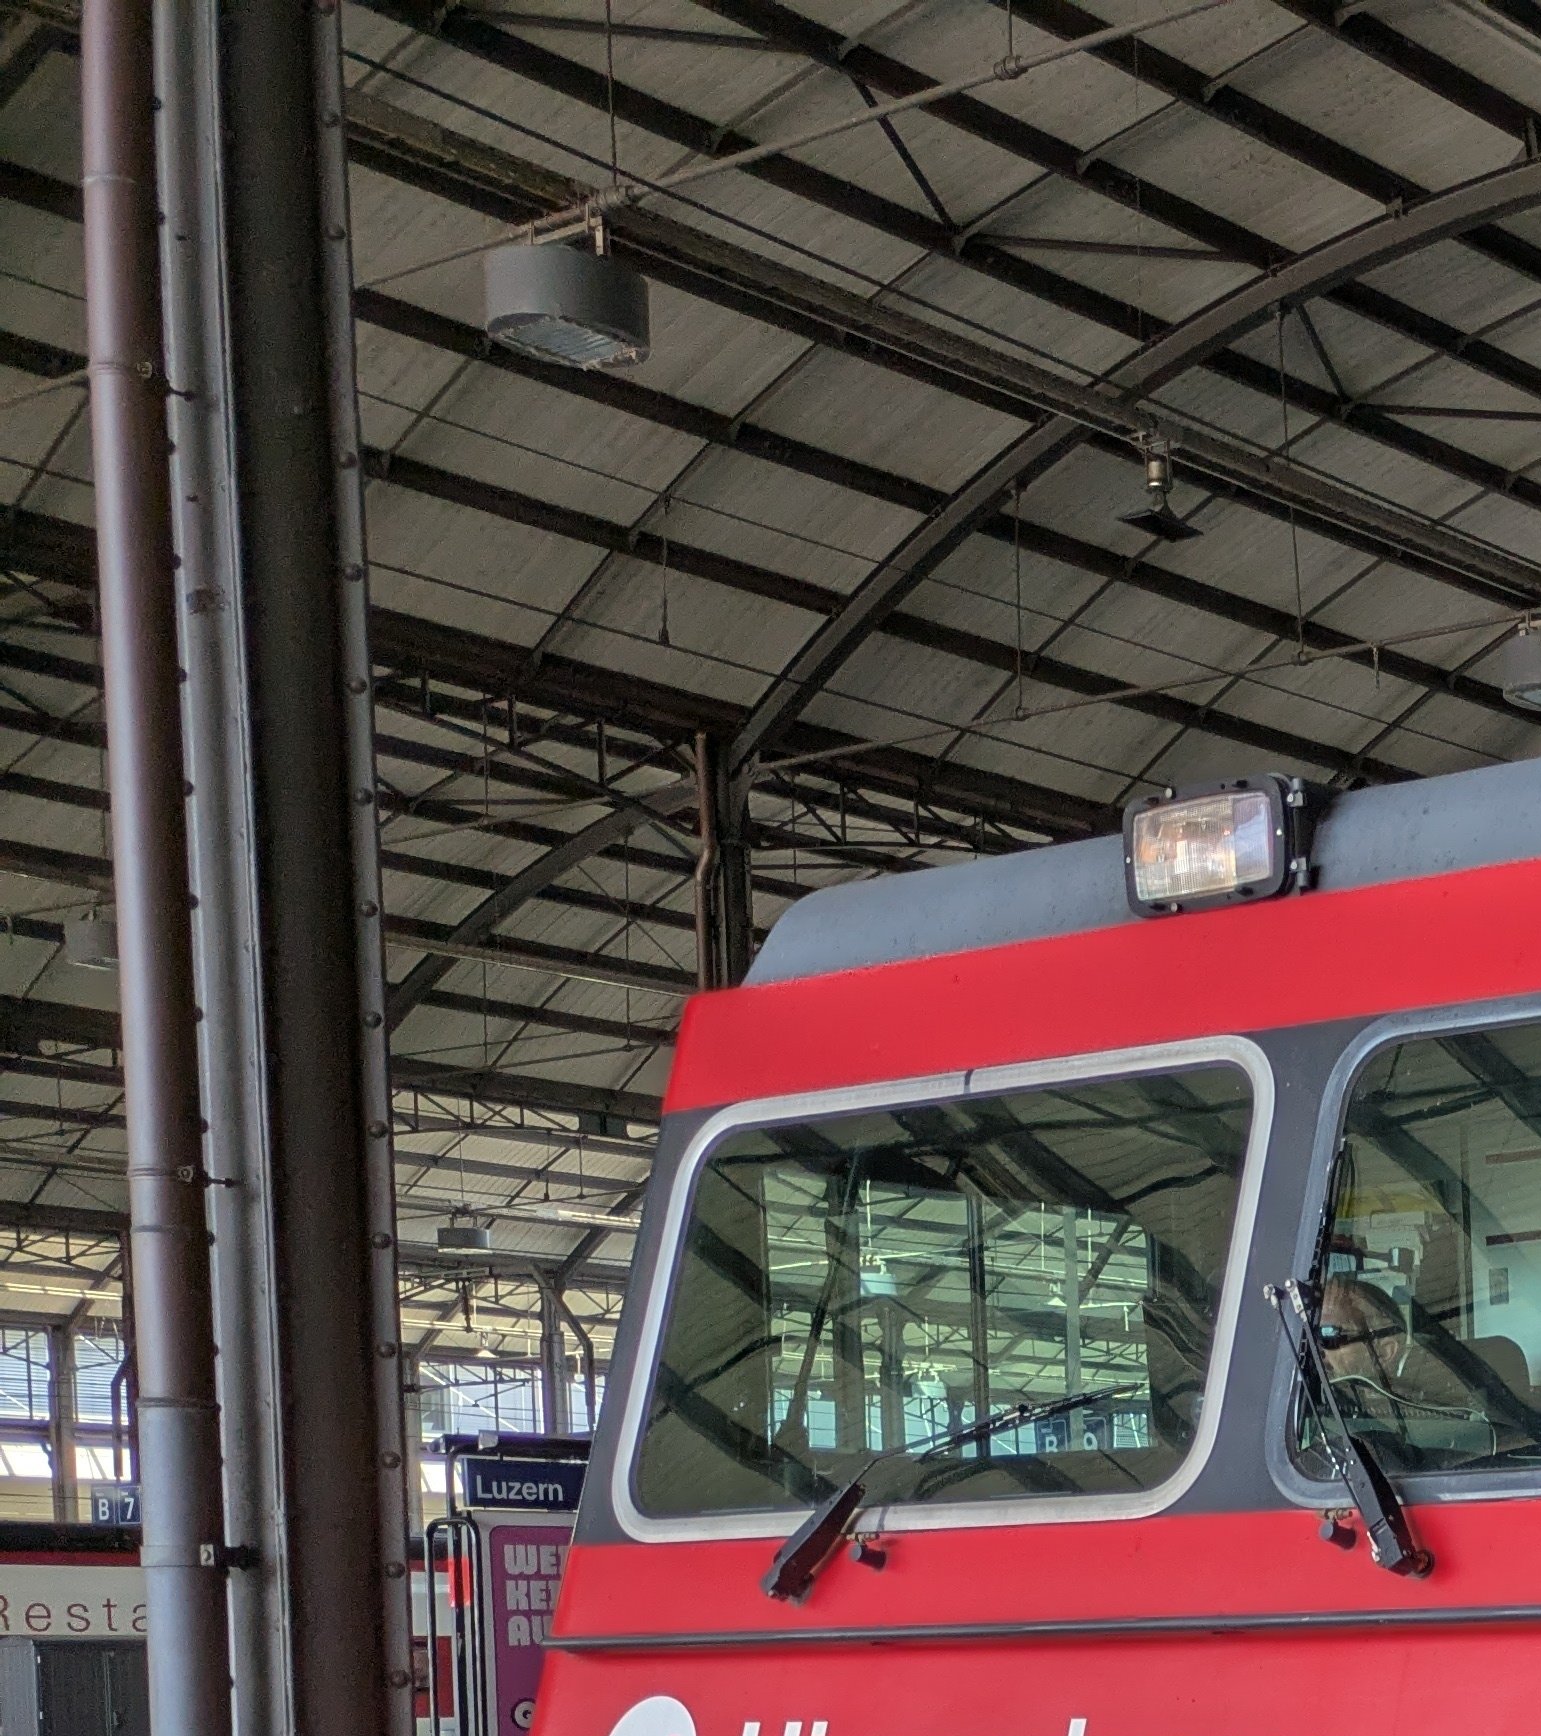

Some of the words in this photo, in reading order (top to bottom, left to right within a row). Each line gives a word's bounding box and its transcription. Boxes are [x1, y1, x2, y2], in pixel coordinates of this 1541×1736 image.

[476, 1474, 564, 1502] Luzern
[99, 1498, 110, 1521] B
[124, 1497, 135, 1520] 7
